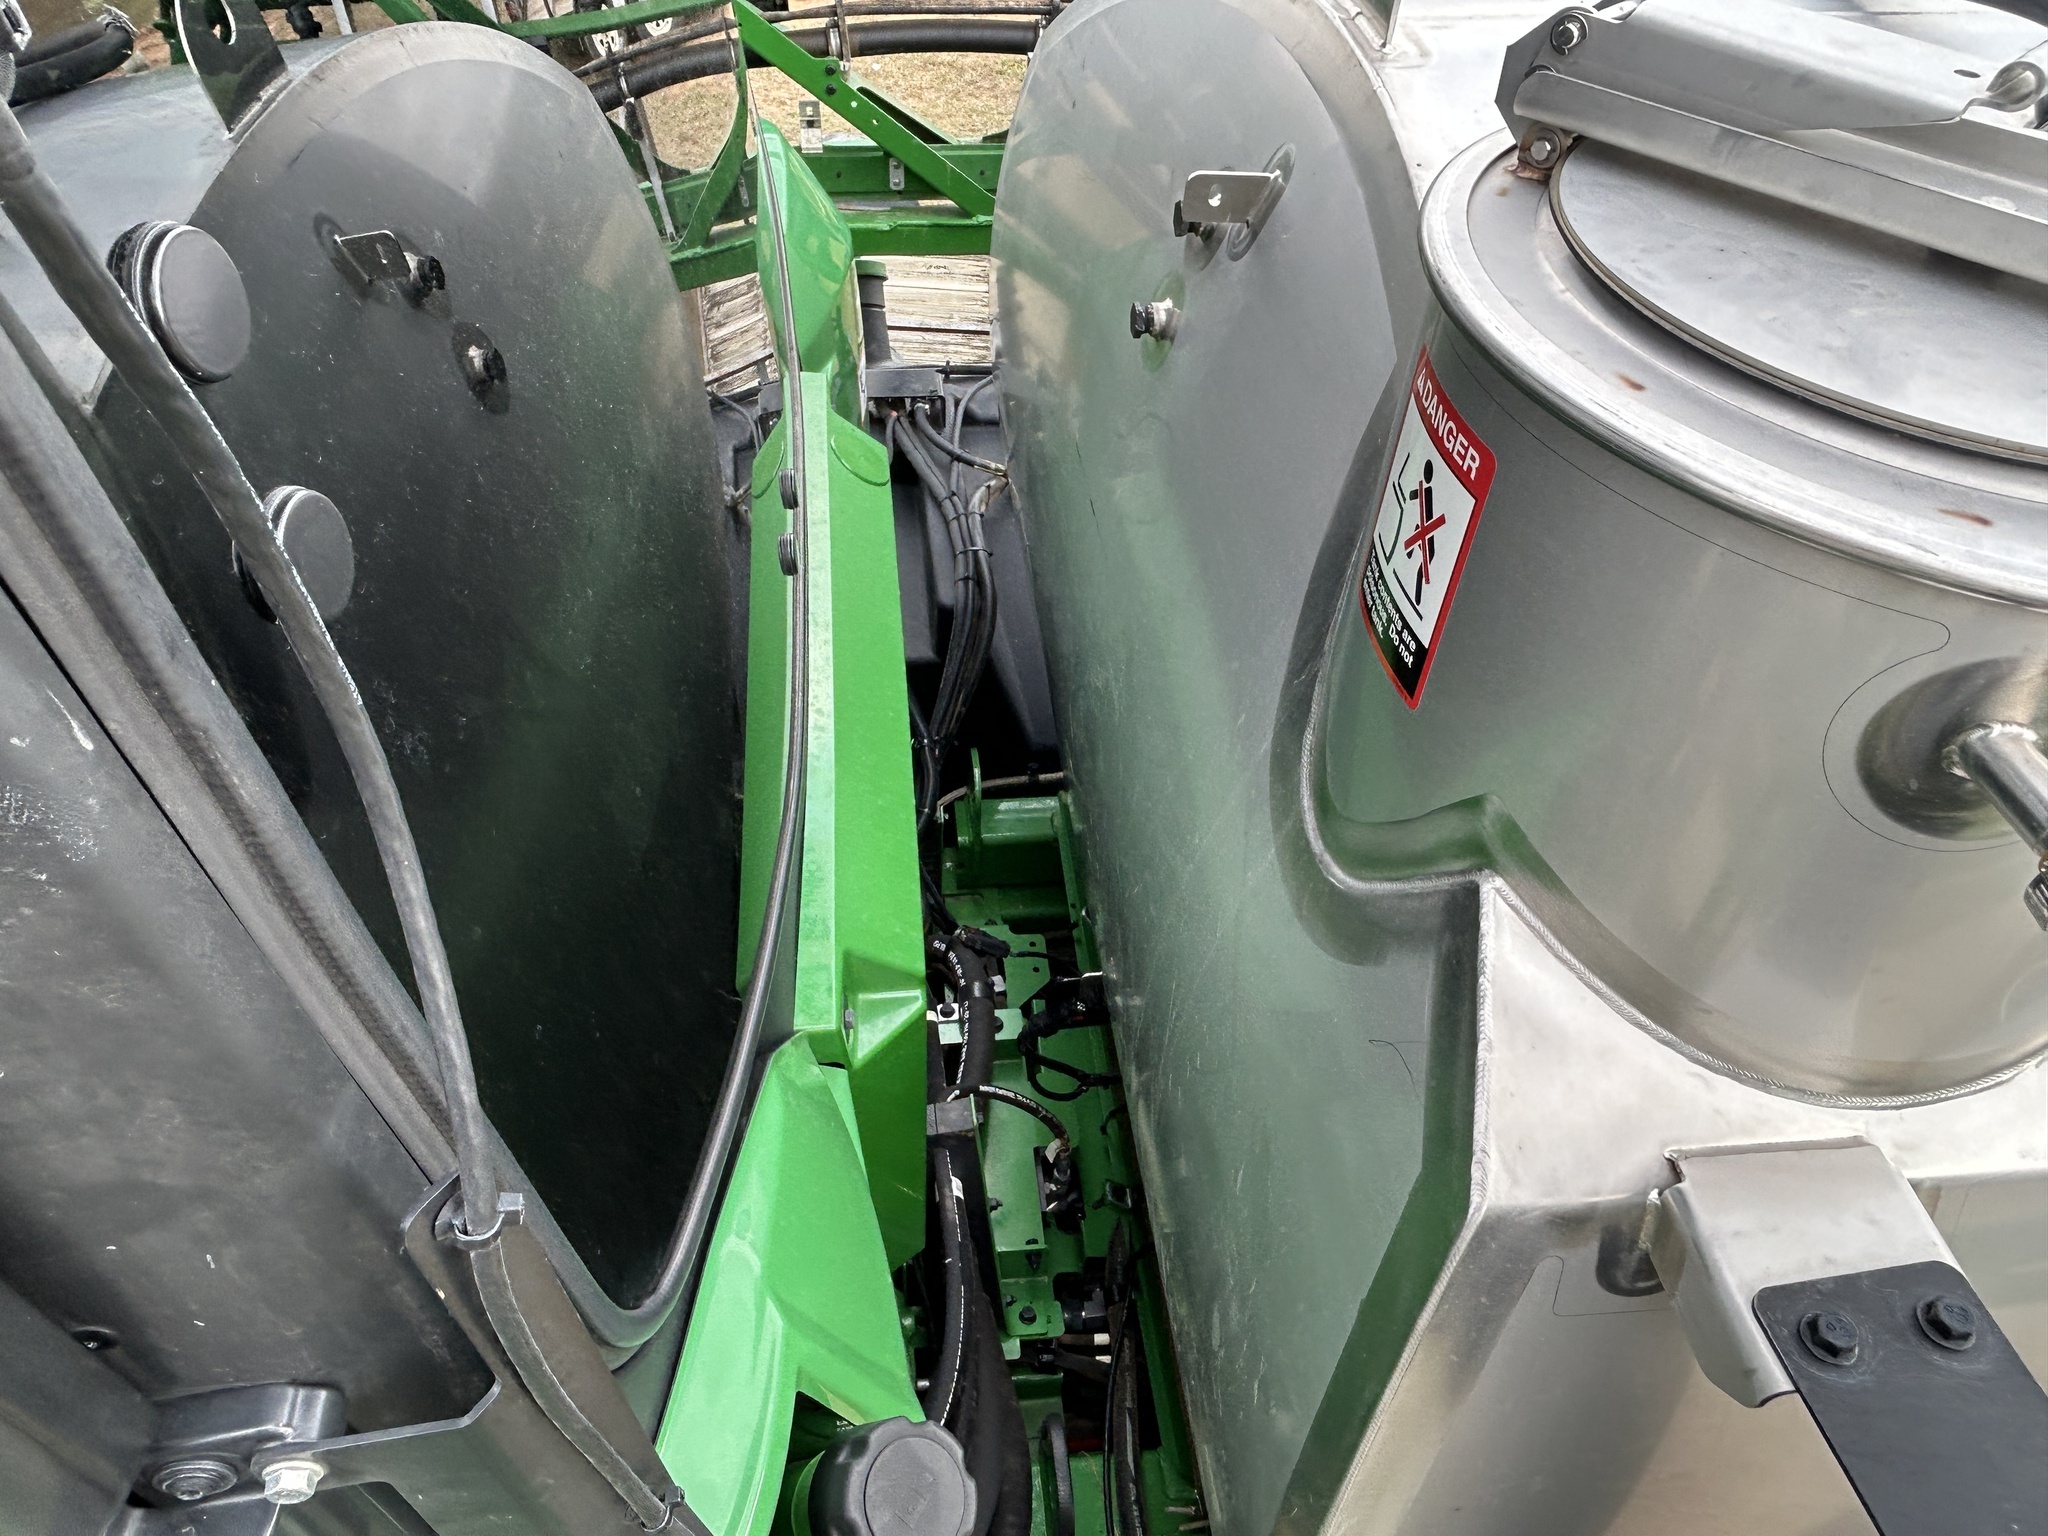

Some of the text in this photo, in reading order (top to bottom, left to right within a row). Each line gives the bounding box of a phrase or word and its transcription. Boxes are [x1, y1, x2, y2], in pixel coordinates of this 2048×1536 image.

[1422, 379, 1480, 481] DANGER
[1377, 578, 1403, 632] contents
[1402, 628, 1417, 652] are
[1388, 623, 1400, 646] Do
[1398, 643, 1414, 669] not
